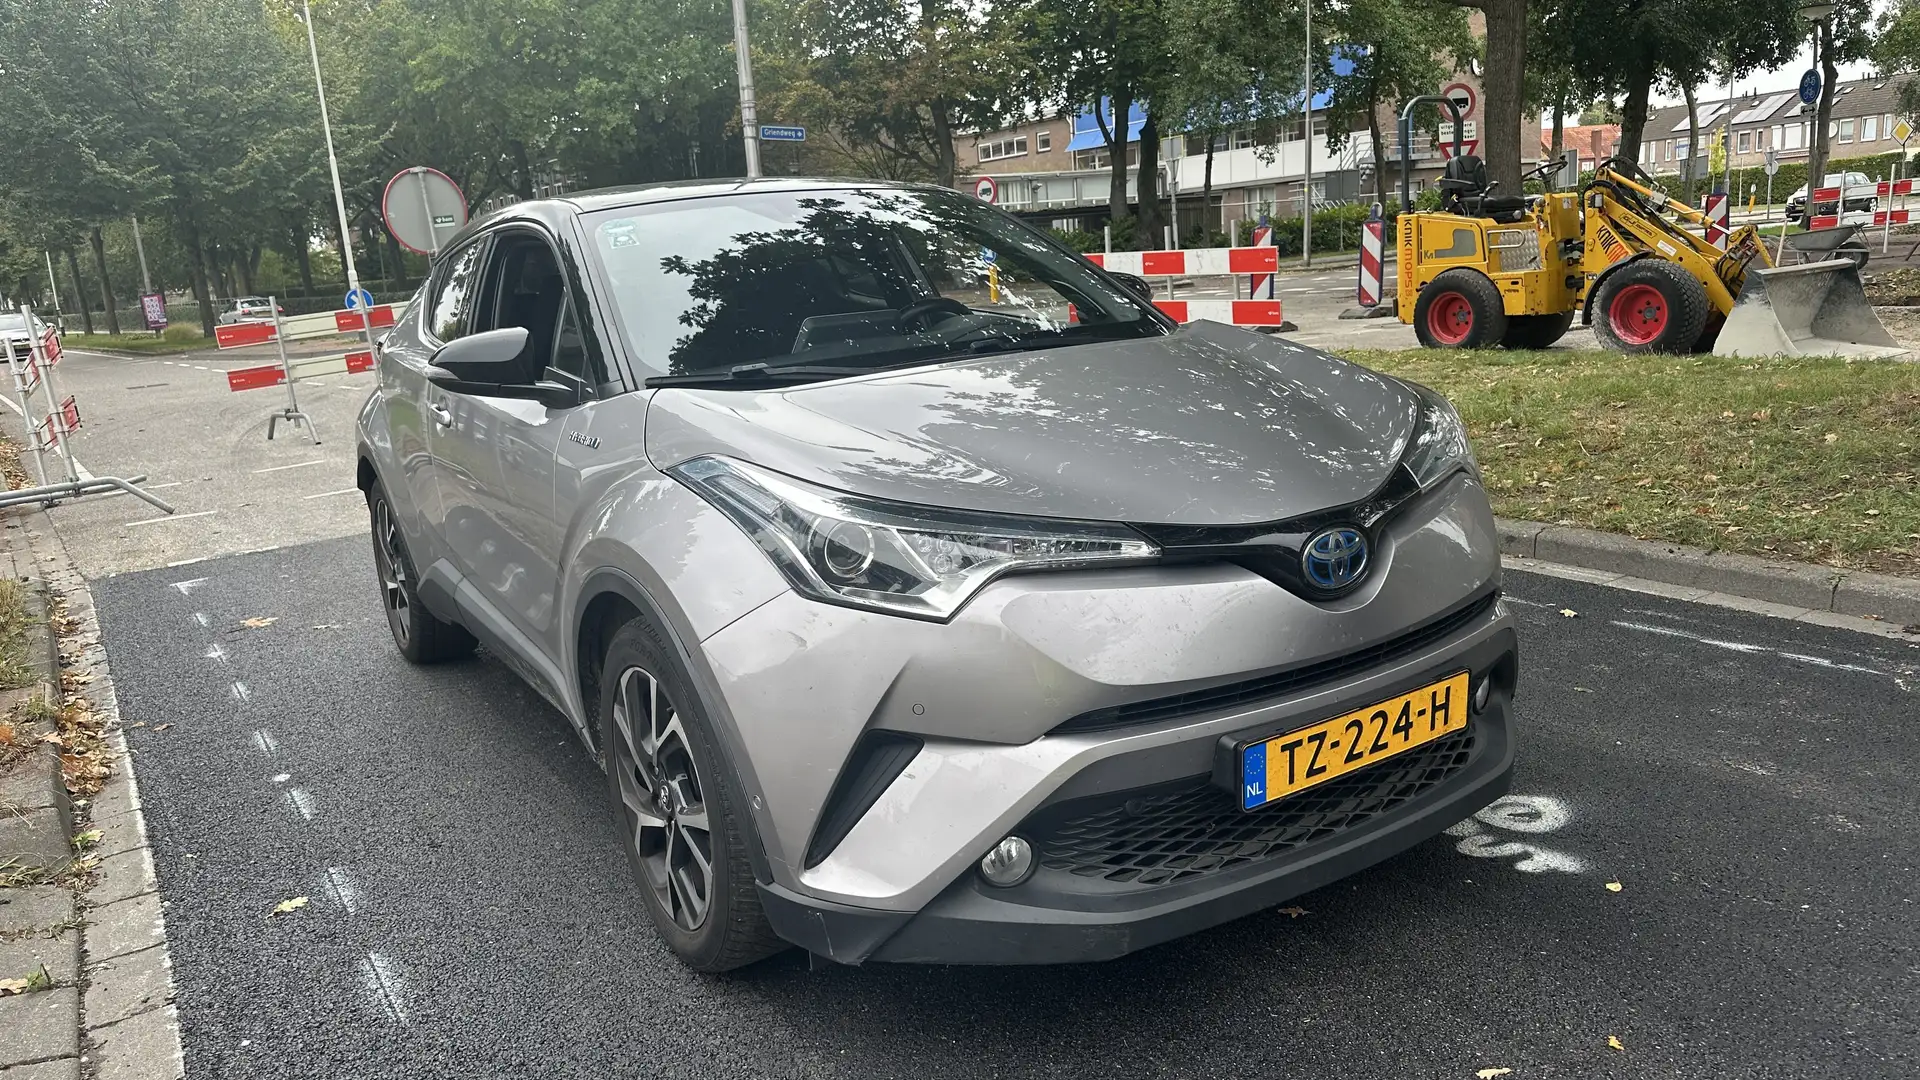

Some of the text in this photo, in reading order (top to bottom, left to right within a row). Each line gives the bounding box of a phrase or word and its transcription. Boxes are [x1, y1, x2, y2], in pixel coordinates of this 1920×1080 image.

[764, 128, 795, 138] Griendweg
[1280, 685, 1451, 785] TZ-224-H
[1246, 782, 1263, 799] NL
